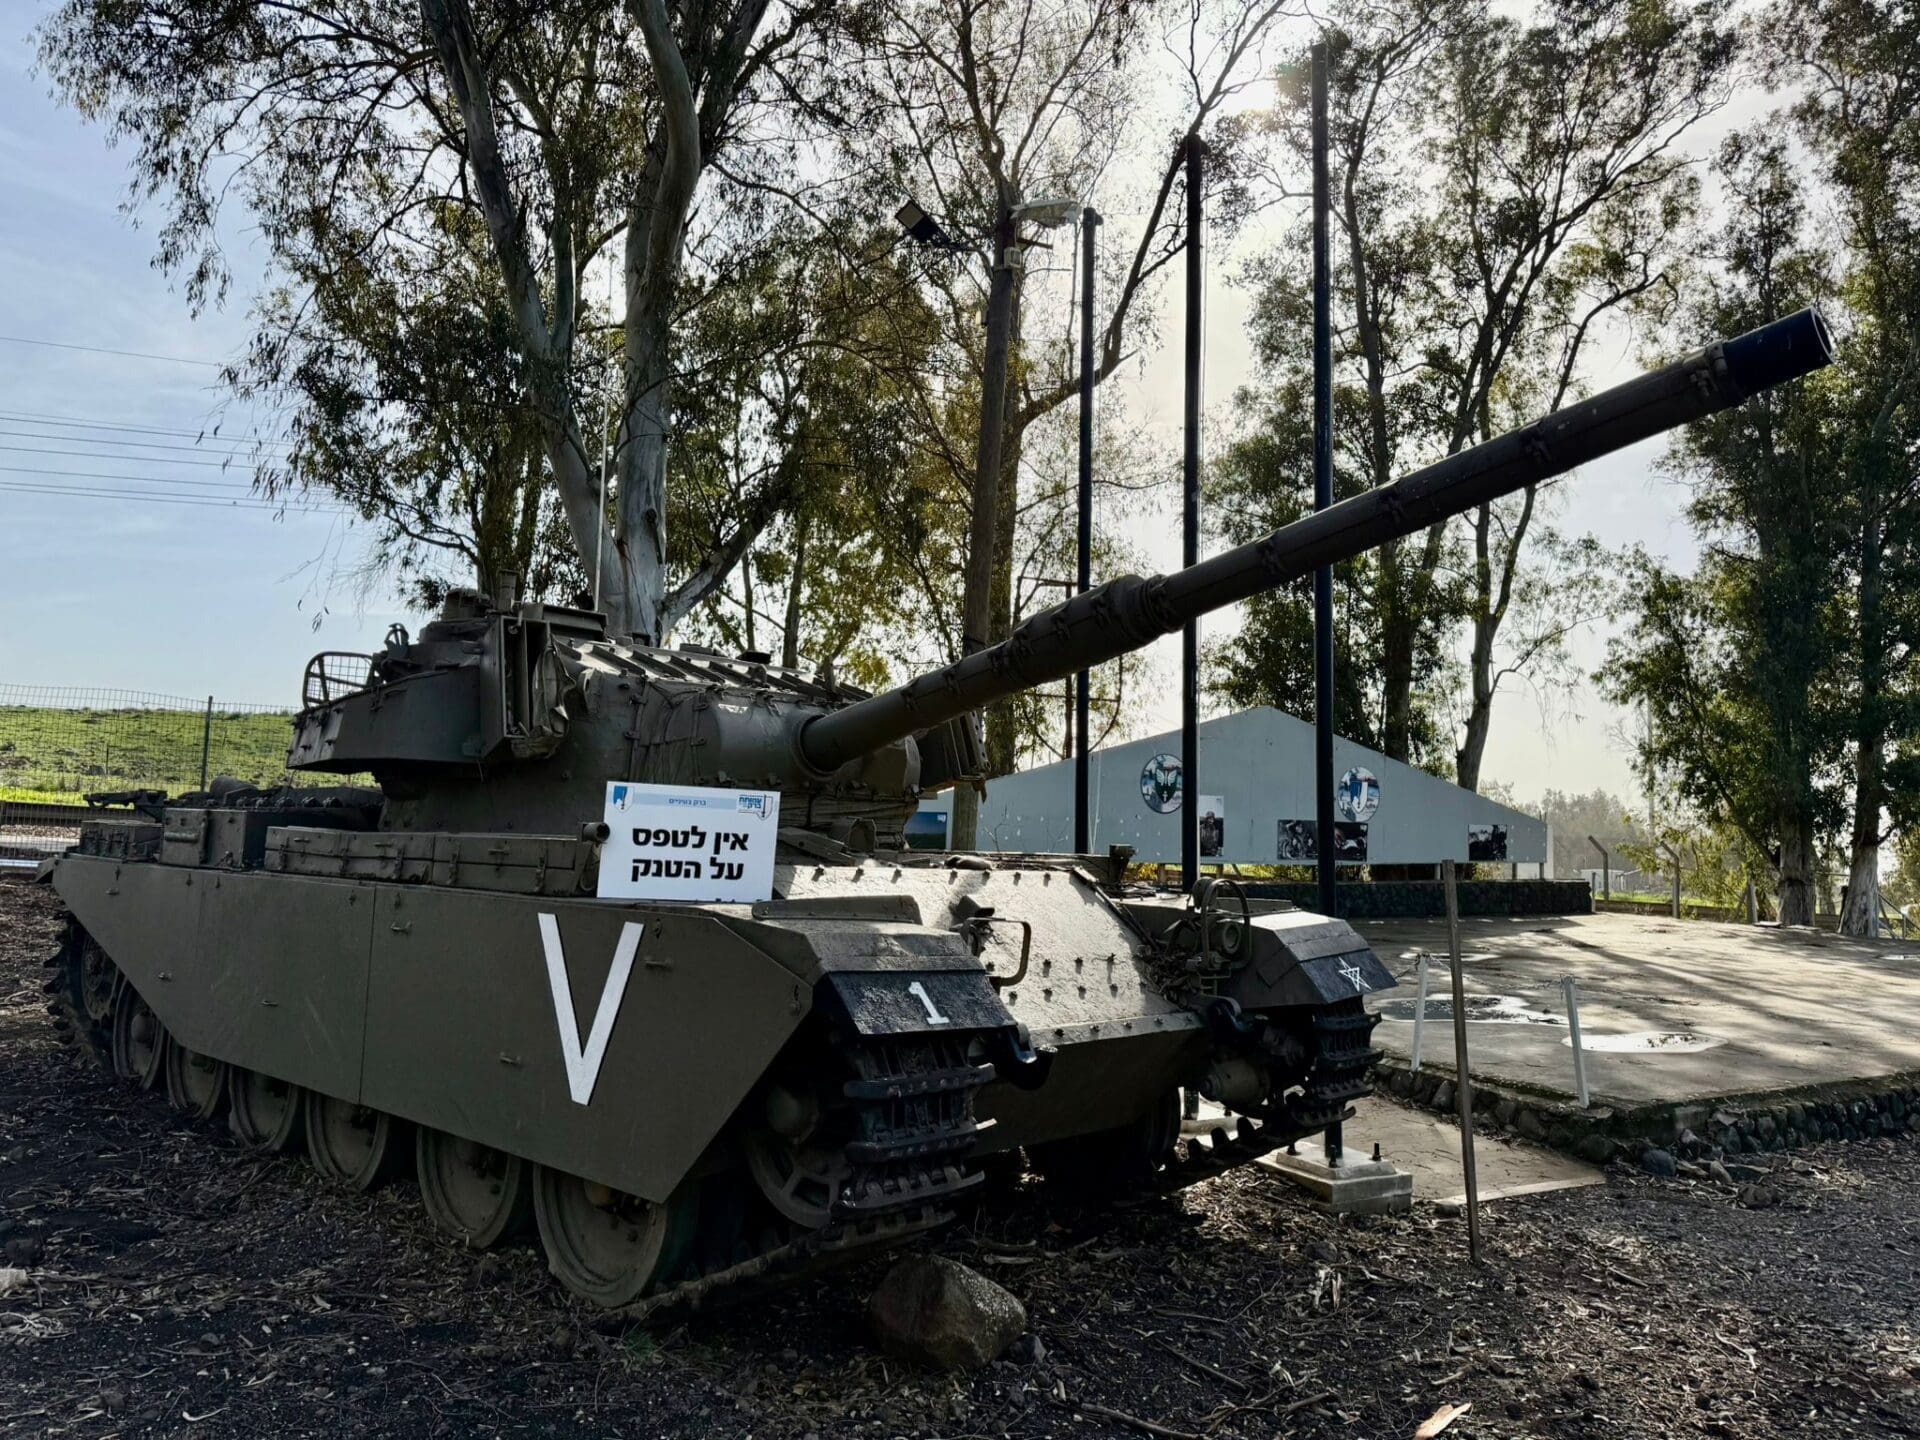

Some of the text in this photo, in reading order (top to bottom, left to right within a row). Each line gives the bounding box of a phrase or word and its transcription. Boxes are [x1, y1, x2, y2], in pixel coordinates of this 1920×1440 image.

[632, 825, 749, 855] אין לטפס
[631, 857, 744, 882] על הטנק
[908, 981, 950, 1025] 1
